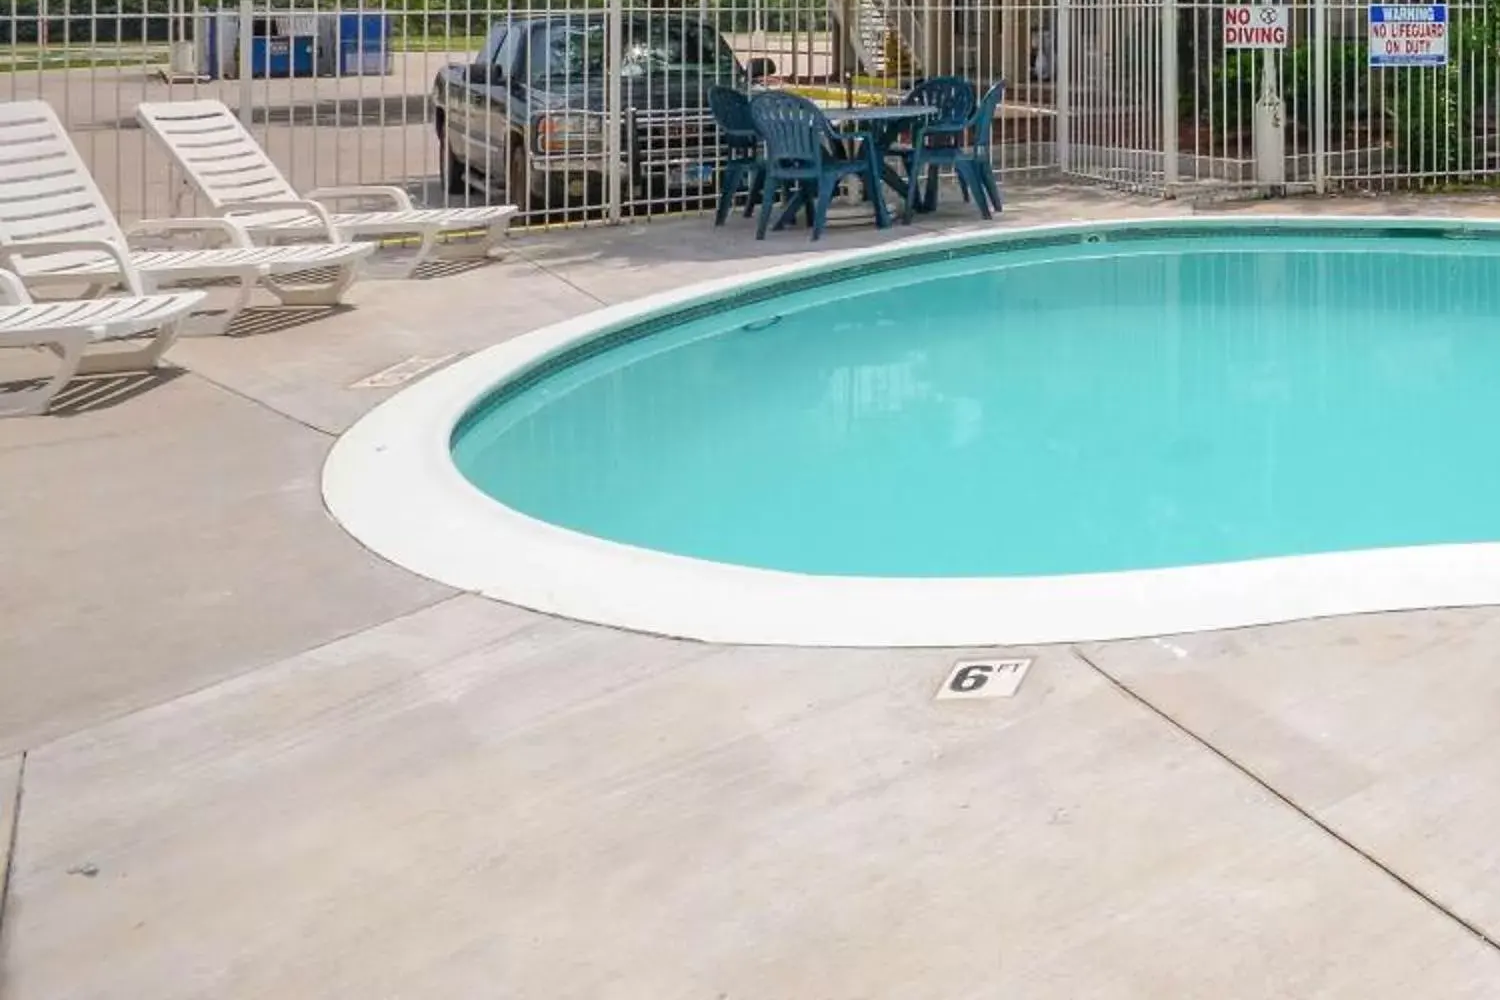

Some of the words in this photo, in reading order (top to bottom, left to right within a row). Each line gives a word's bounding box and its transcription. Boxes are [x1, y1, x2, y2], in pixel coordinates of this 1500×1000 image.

[1226, 8, 1251, 25] NO
[1226, 27, 1285, 44] DIVING
[1373, 23, 1387, 38] NO
[1391, 23, 1444, 38] LIFEGUARD
[1385, 39, 1400, 54] ON
[1405, 39, 1431, 54] DUTY
[949, 664, 993, 693] 6
